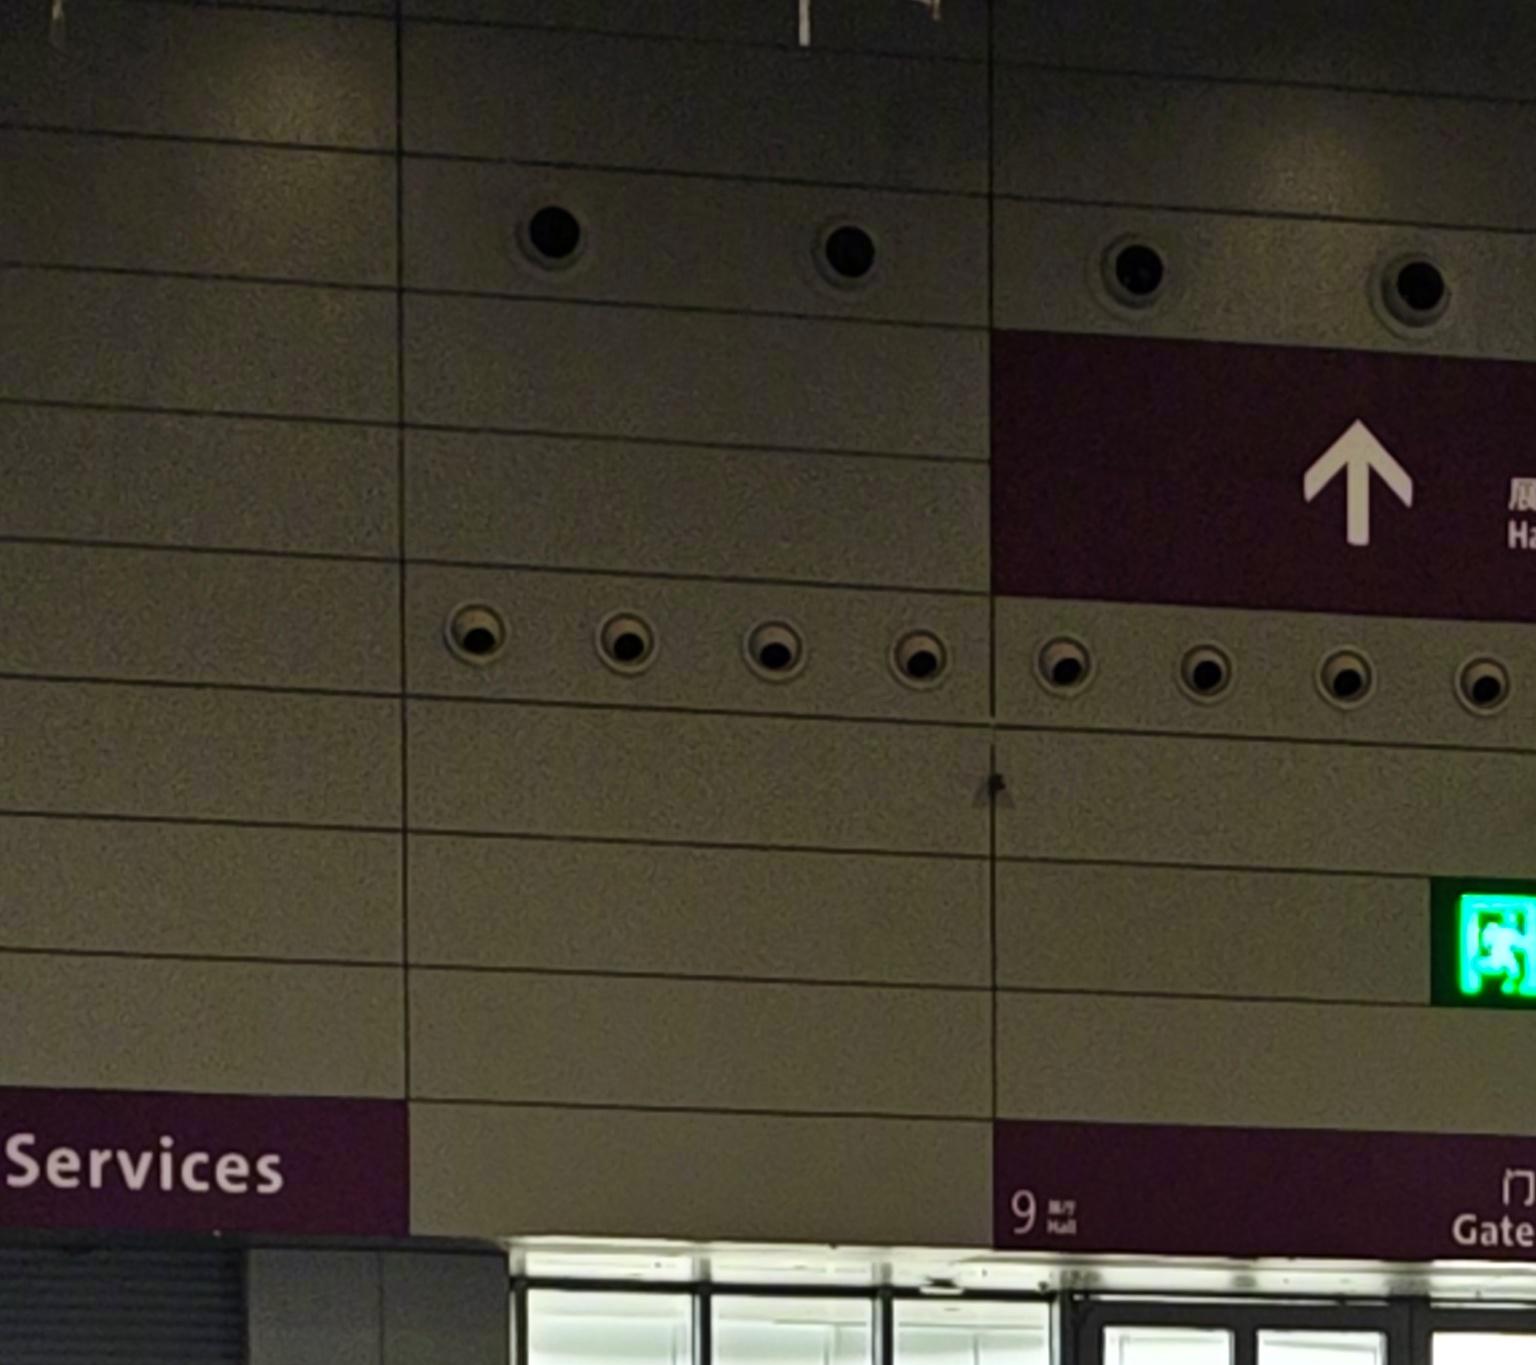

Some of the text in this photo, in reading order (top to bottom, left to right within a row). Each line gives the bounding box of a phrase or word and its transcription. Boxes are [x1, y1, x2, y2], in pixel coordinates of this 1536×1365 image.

[5, 1133, 284, 1194] Services
[1503, 1168, 1536, 1207] 门
[1011, 1189, 1036, 1235] 9
[1453, 1213, 1535, 1247] Gate
